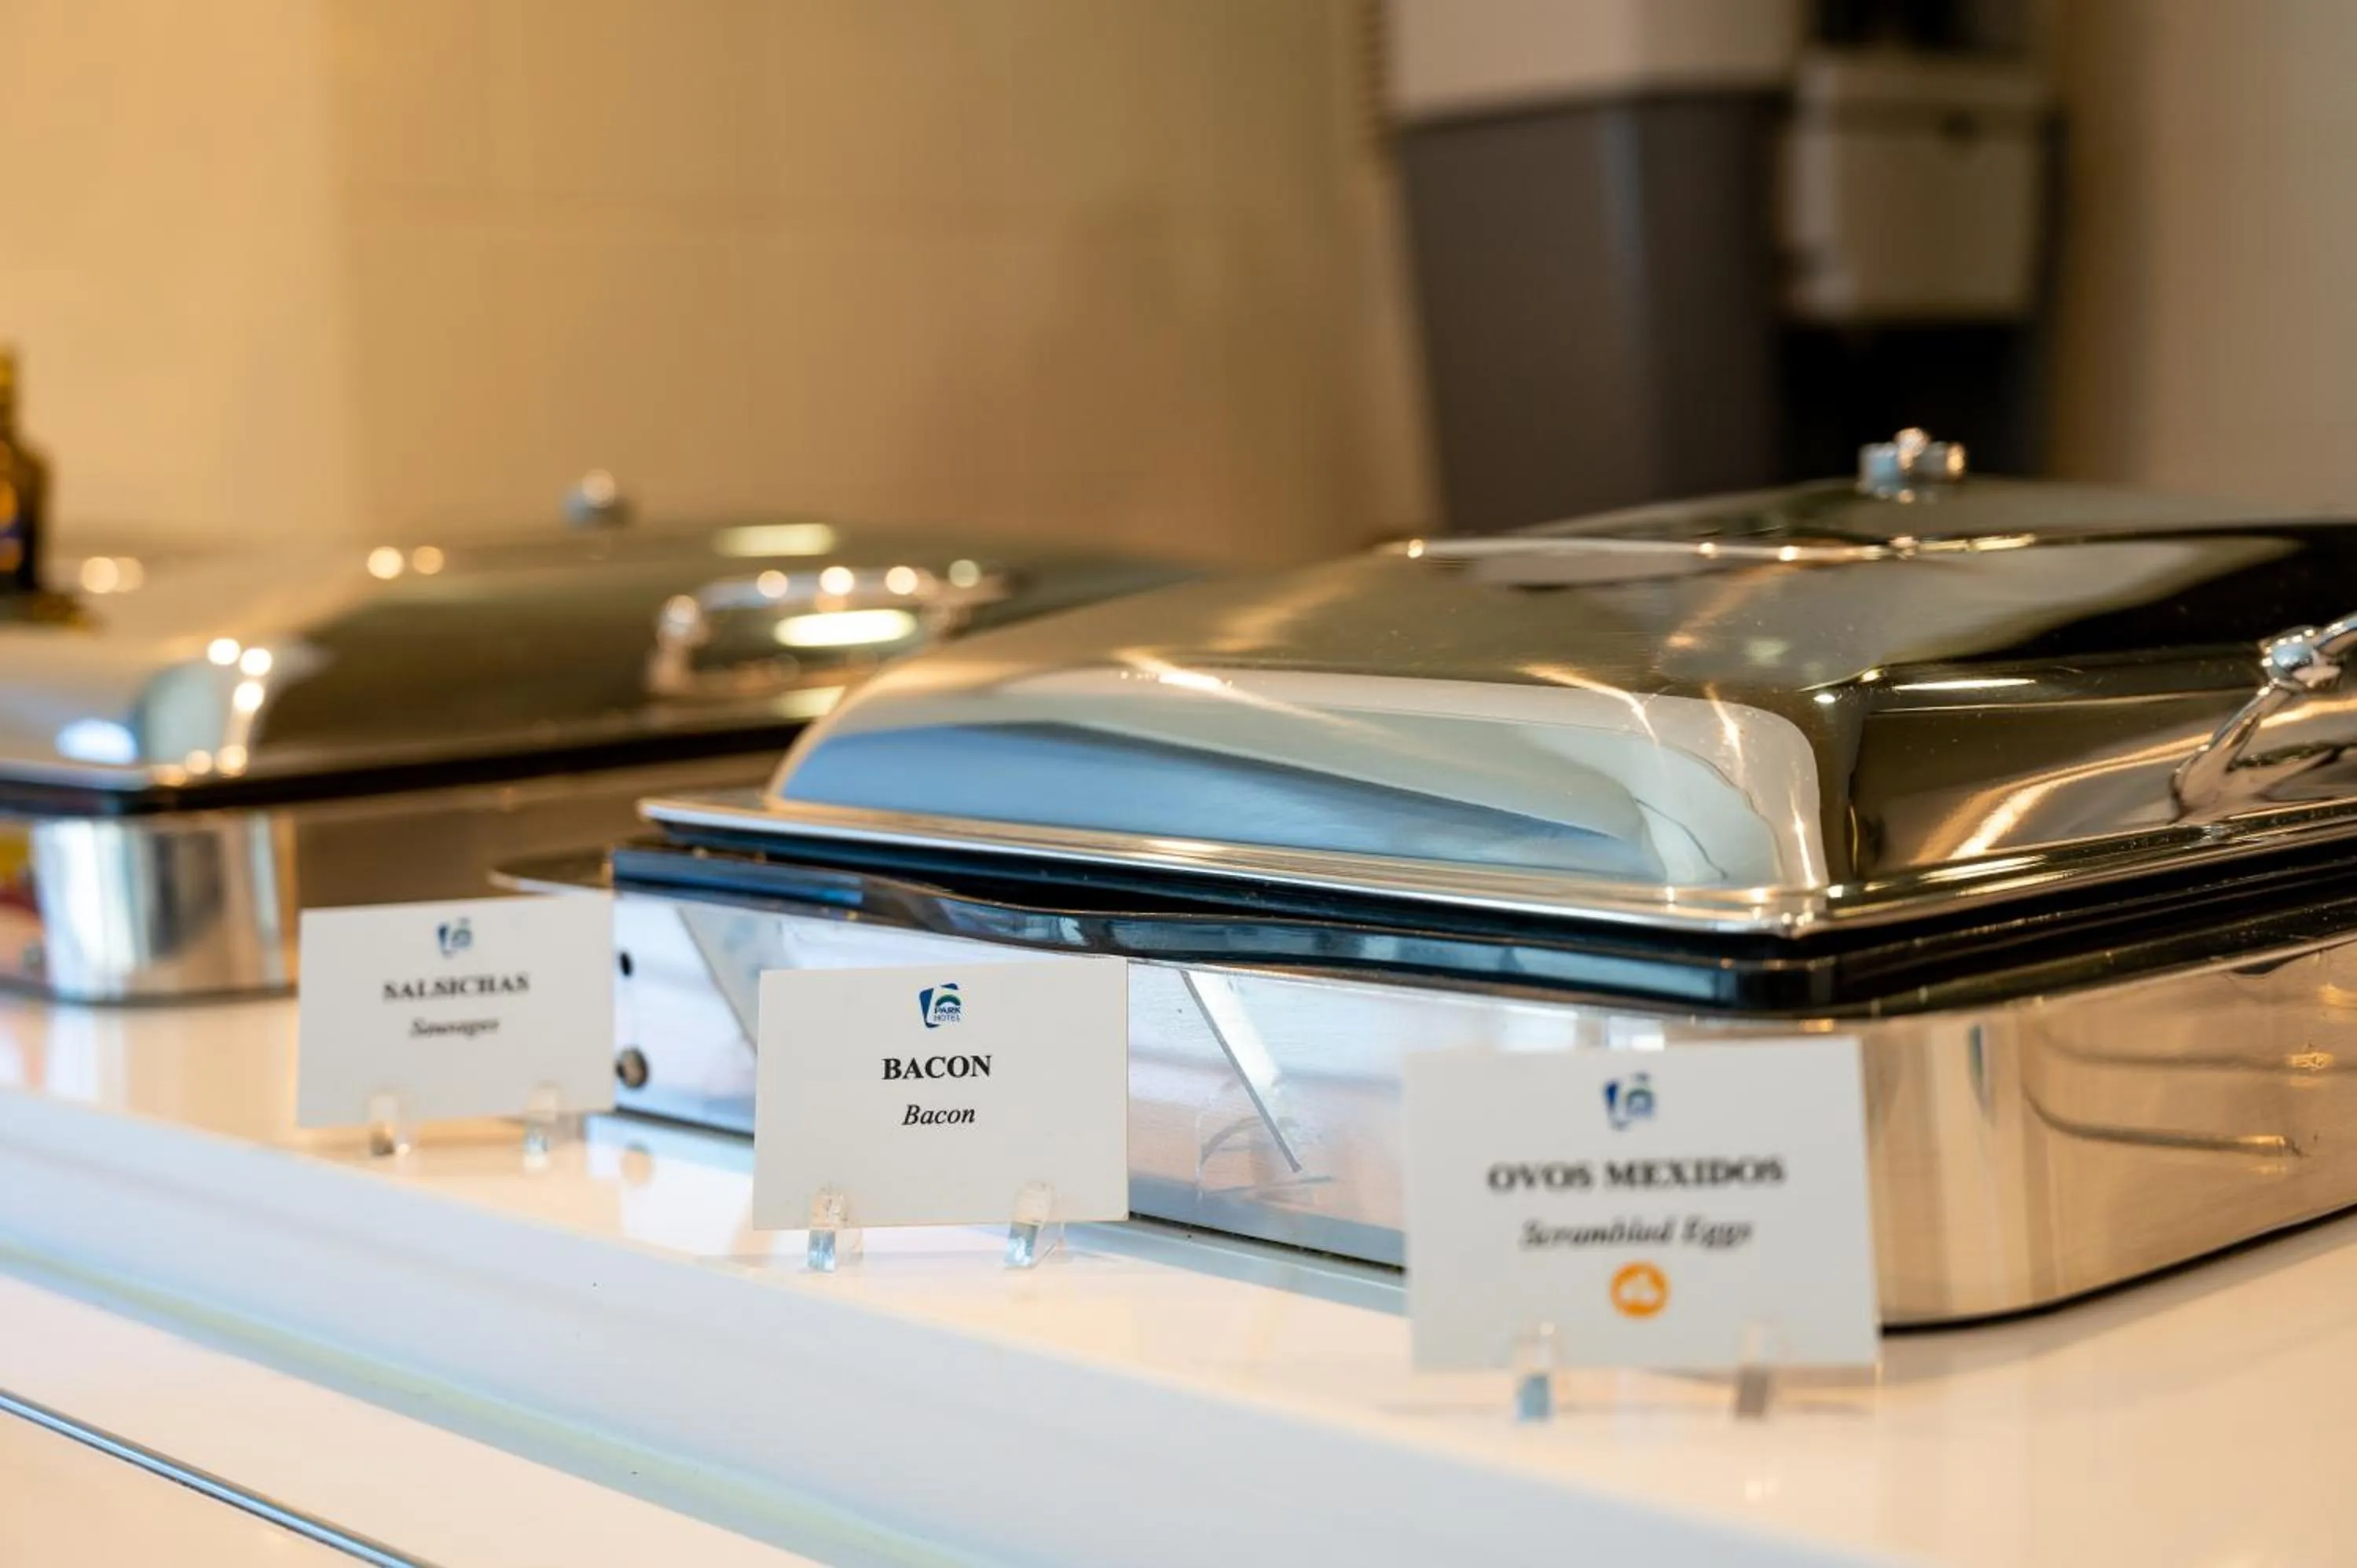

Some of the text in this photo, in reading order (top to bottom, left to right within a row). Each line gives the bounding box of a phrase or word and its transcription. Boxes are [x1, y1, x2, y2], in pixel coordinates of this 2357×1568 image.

[383, 973, 530, 1002] SALSICHAS
[882, 1055, 992, 1079] BACON
[902, 1104, 975, 1125] Bacon
[1487, 1156, 1786, 1191] OVOS MEXIDOS
[1520, 1214, 1754, 1249] Scrambled Eggs
